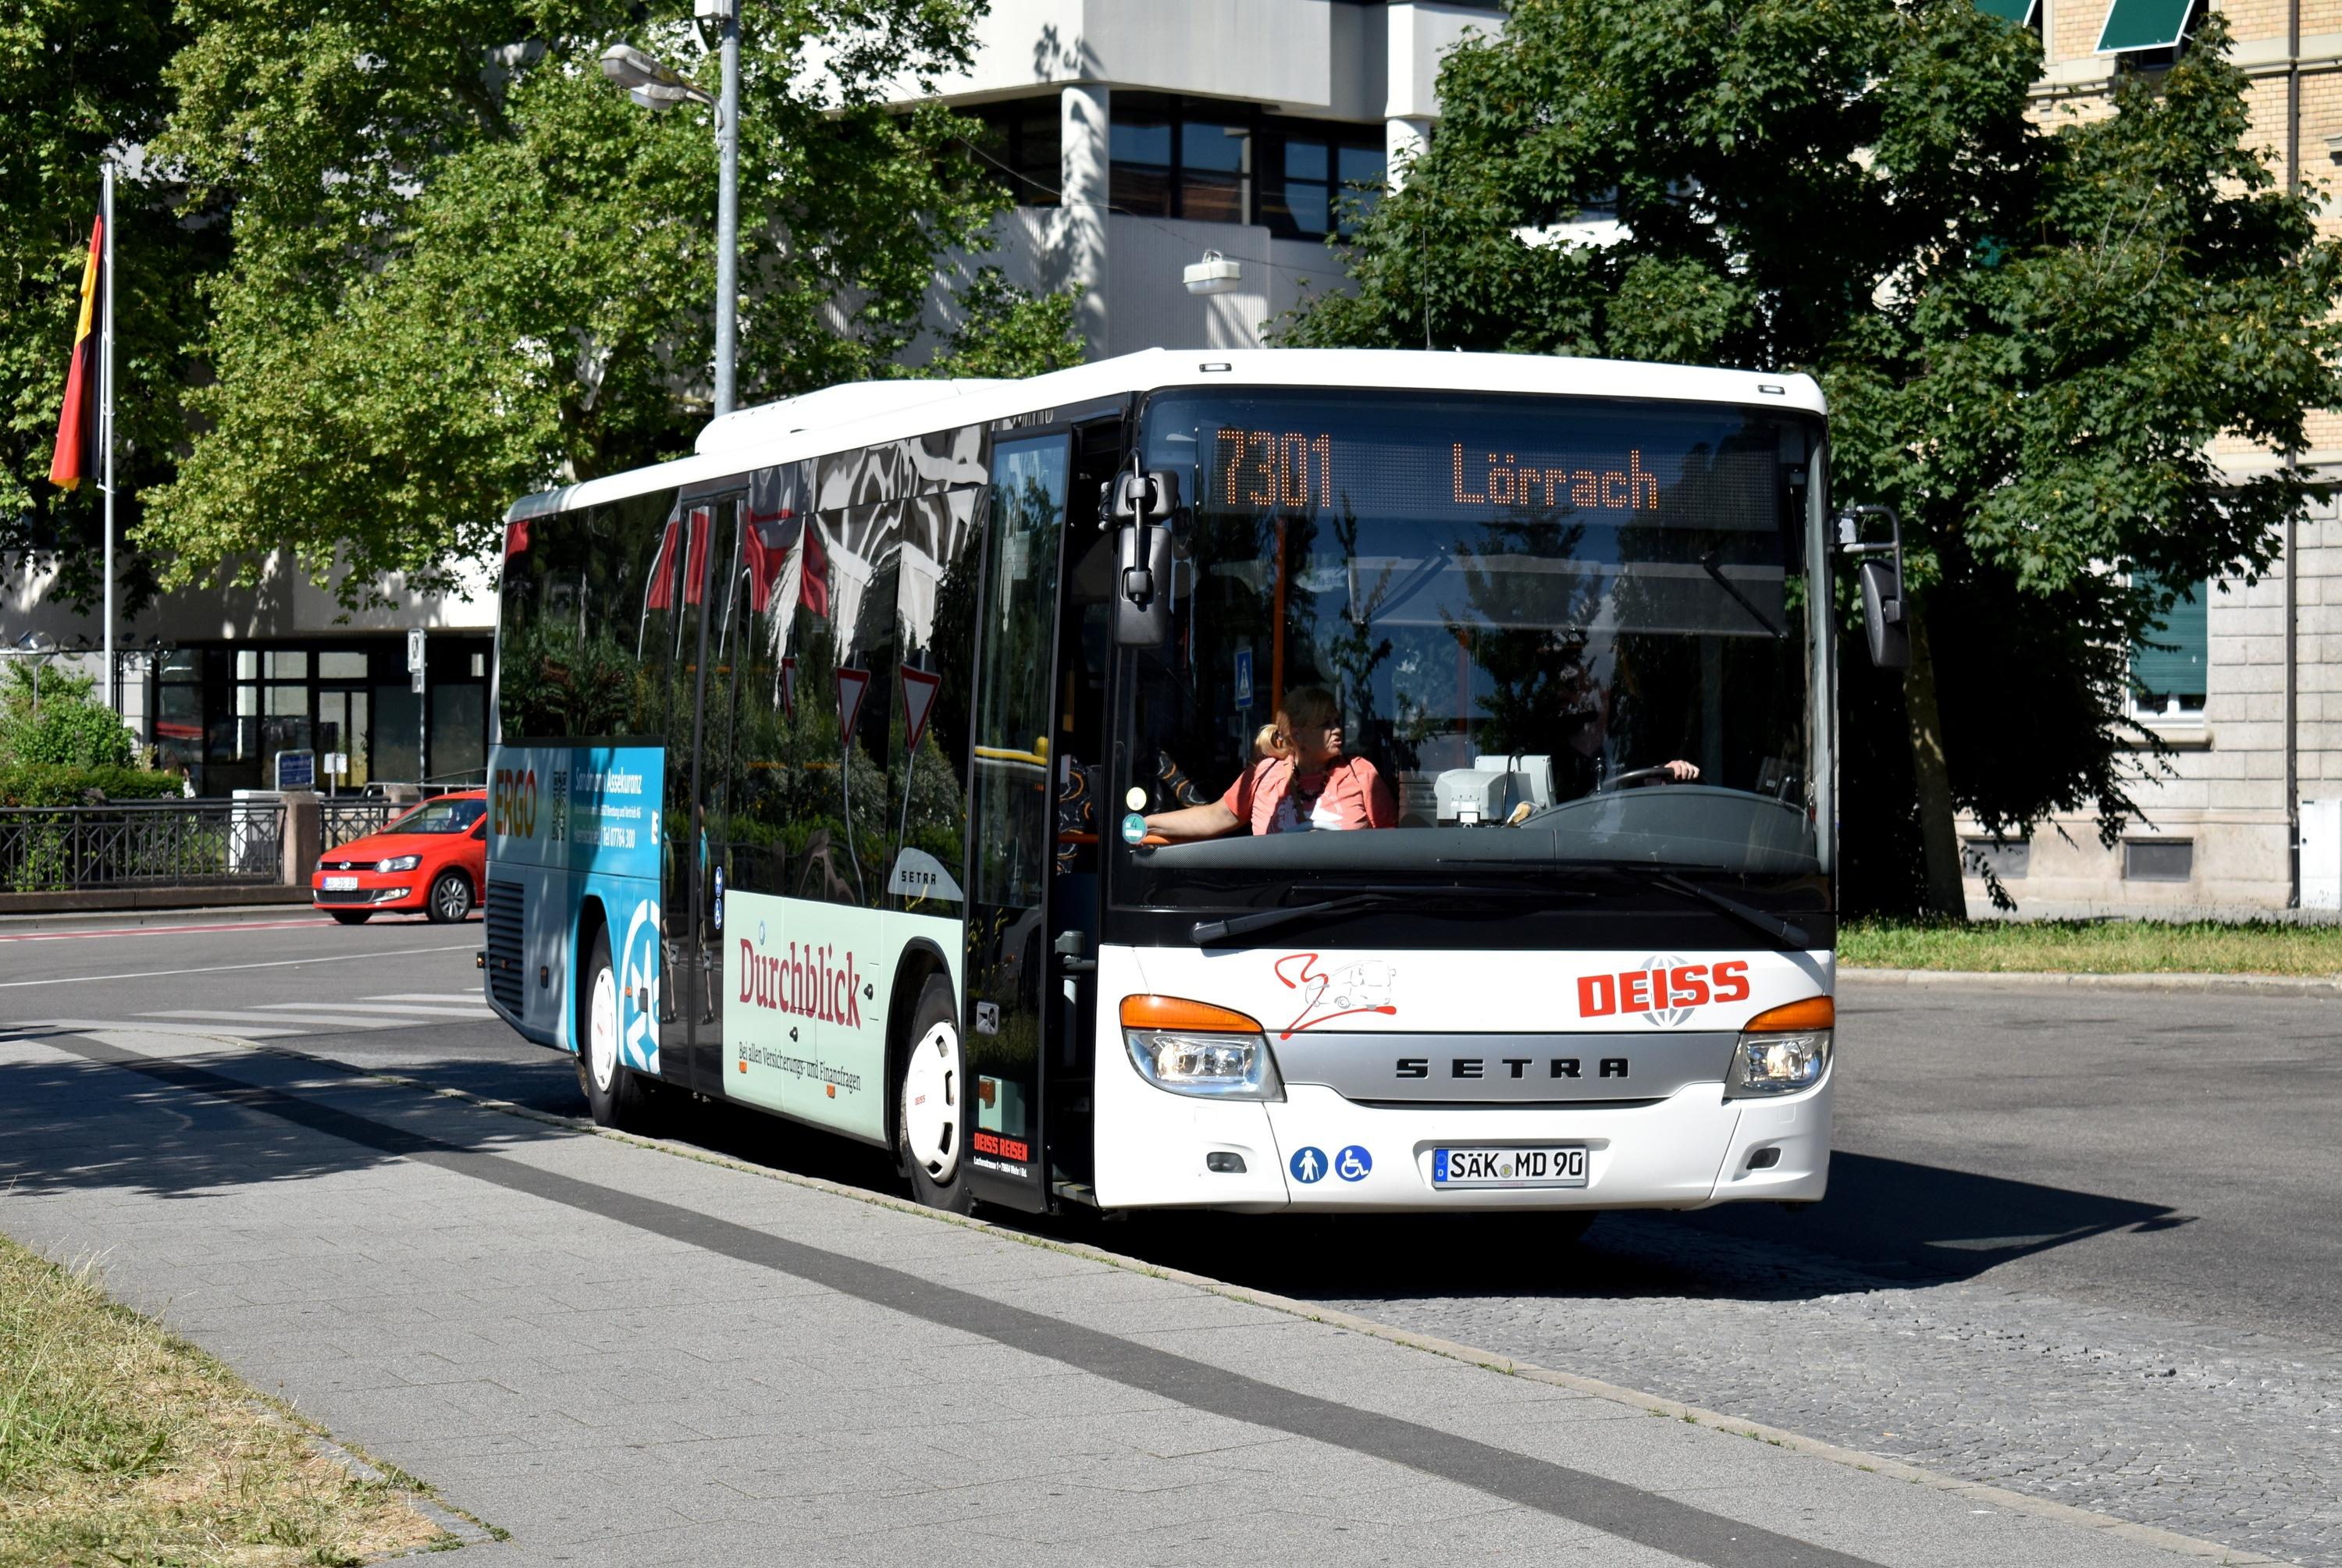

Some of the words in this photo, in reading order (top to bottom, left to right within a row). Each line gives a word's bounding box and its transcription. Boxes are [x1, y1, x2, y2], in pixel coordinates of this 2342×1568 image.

[1218, 431, 1329, 507] 7301
[1453, 443, 1657, 509] Lörrach
[607, 766, 642, 795] Assekuranz
[495, 769, 536, 839] ERGO
[610, 827, 625, 848] 07764
[625, 829, 635, 849] 300
[1130, 817, 1137, 830] 4
[902, 870, 936, 884] SETRA
[740, 938, 860, 1030] Durchblick
[1577, 960, 1749, 1018] DEISS
[739, 1042, 748, 1060] Bei
[749, 1043, 762, 1066] allen
[763, 1047, 806, 1079] Versicherungs-
[806, 1060, 819, 1079] und
[820, 1061, 861, 1094] Finanzfragen
[1396, 1058, 1629, 1079] SETRA
[974, 1132, 998, 1154] DEISS
[999, 1138, 1027, 1162] REISEN
[1450, 1153, 1499, 1178] SÄK
[1515, 1152, 1547, 1177] MD
[1554, 1152, 1582, 1176] 90
